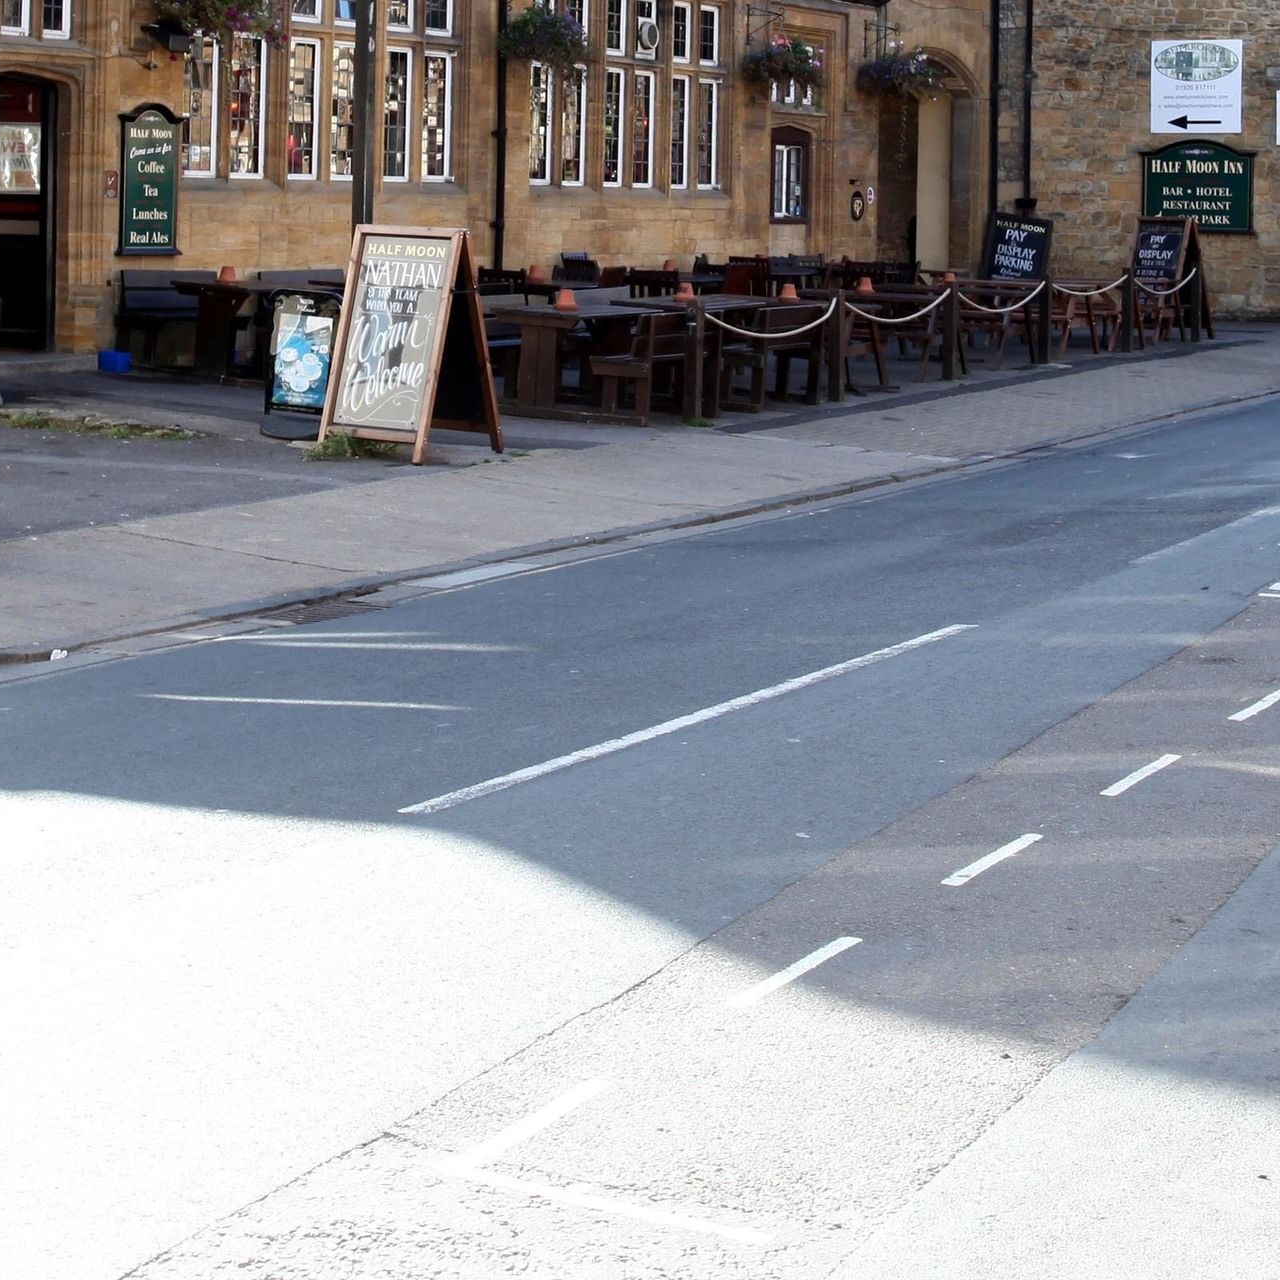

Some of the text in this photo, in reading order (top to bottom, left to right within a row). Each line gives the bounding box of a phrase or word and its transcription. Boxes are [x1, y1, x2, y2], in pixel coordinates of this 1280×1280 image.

[130, 128, 173, 139] HALF MOON
[130, 146, 146, 159] Come
[162, 143, 172, 155] for
[138, 161, 165, 173] Coffee
[1152, 160, 1243, 174] HALF MOON INN
[143, 185, 158, 196] Tea
[1162, 187, 1232, 197] BAR HOTEL
[1163, 200, 1232, 210] RESTAURANT
[132, 208, 168, 220] Lunches
[1202, 215, 1230, 224] PARK
[996, 220, 1046, 233] HALF MOON
[130, 231, 169, 243] Real Ales
[1005, 228, 1028, 242] PAY
[1150, 235, 1166, 243] PAY
[368, 243, 446, 258] HALF MOON
[997, 244, 1037, 260] DISPLAY
[1139, 250, 1173, 259] DISPLAY
[995, 254, 1033, 272] PARKING
[364, 260, 442, 289] NATHAN
[395, 289, 419, 302] TEAM
[389, 301, 404, 313] YOU
[349, 314, 421, 363] Warm
[342, 361, 424, 412] Welcome
